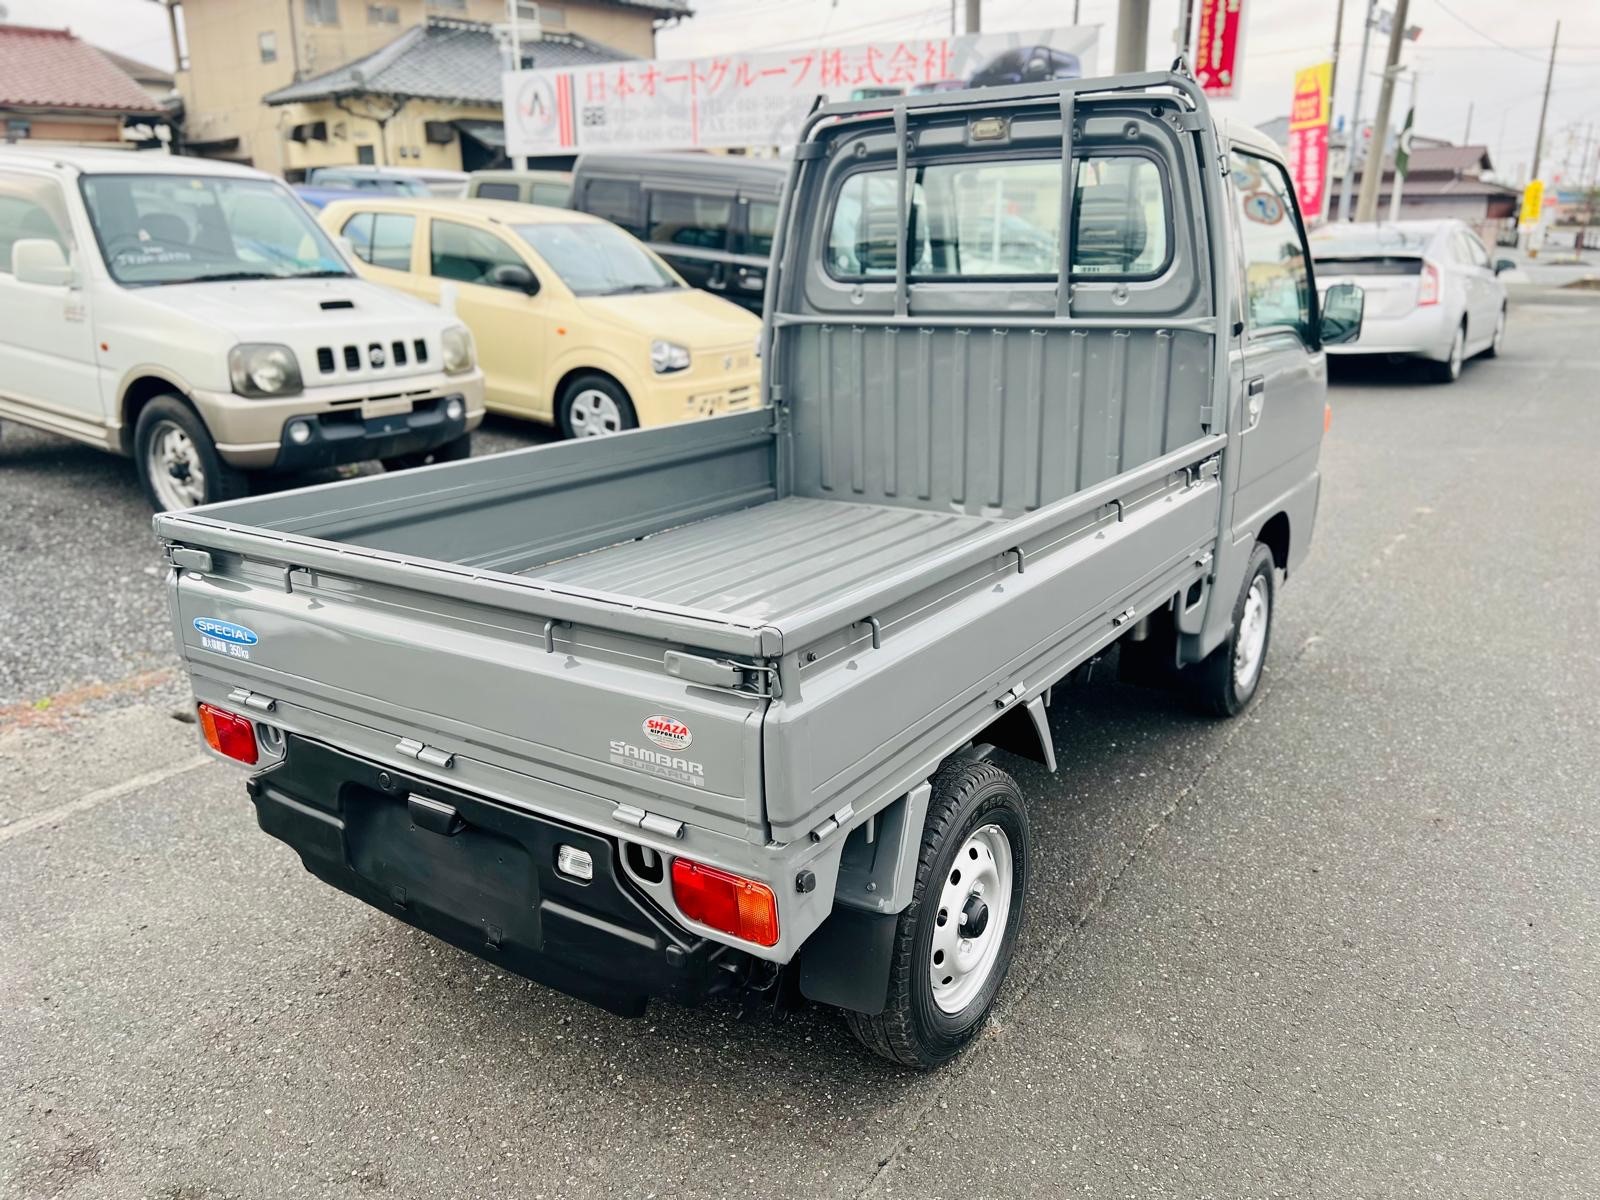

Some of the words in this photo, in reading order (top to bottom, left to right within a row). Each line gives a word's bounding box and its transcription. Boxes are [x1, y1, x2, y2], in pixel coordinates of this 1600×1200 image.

[585, 40, 955, 101] 日本オートグループ株式会社
[198, 620, 252, 642] SPECIAL
[647, 719, 688, 736] SHAZA
[650, 728, 673, 738] NIPPON
[673, 733, 684, 741] LLC
[609, 741, 704, 776] SAMBAR
[622, 758, 692, 781] SUBARU
